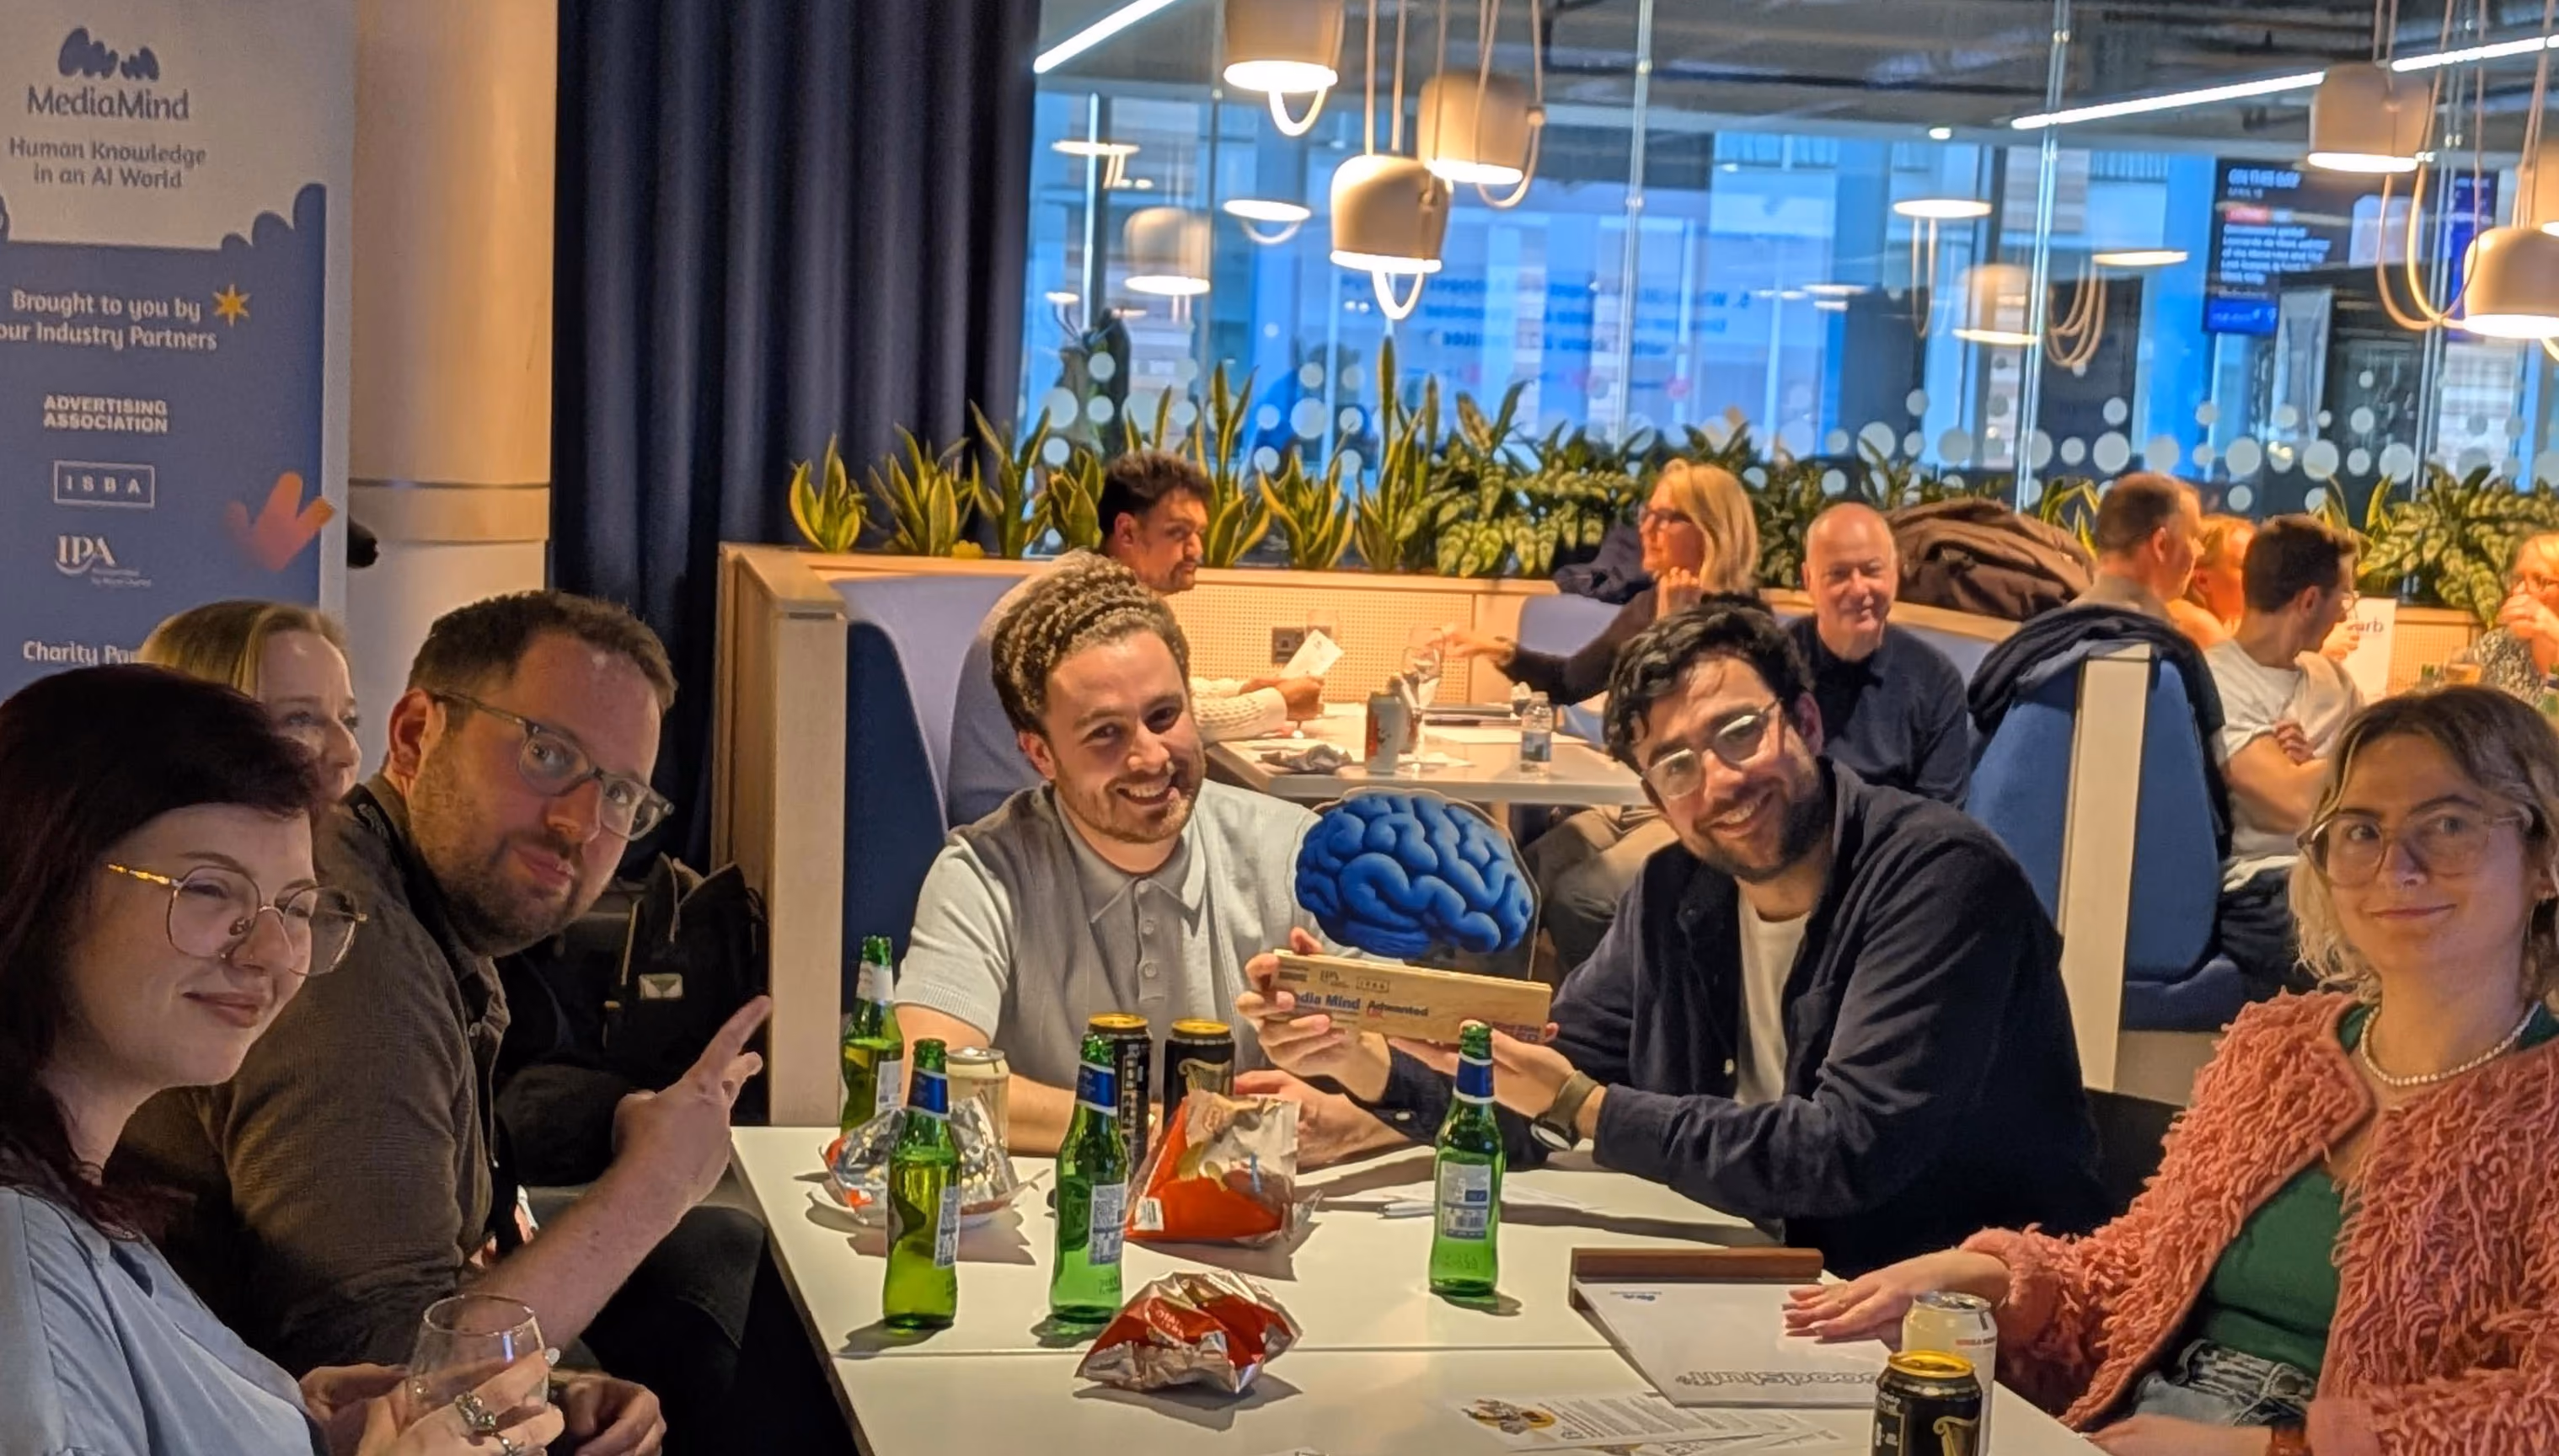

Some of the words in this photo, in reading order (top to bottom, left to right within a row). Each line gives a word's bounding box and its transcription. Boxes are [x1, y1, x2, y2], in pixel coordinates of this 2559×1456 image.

[27, 85, 190, 120] MediaMind
[8, 136, 83, 160] Human
[91, 141, 207, 170] Knowledge
[34, 163, 53, 184] in
[59, 168, 84, 185] an
[91, 167, 112, 186] AI
[119, 169, 183, 190] World
[12, 290, 94, 316] Brought
[100, 295, 122, 315] to
[128, 299, 169, 322] you
[174, 297, 201, 324] by
[36, 322, 124, 351] Industry
[130, 326, 217, 350] Partners
[44, 394, 168, 416] ADVERTISING
[43, 412, 168, 432] ASSOCIATION
[56, 534, 116, 567] IPA
[23, 640, 98, 666] Charity
[104, 645, 138, 664] Par
[1325, 993, 1362, 1010] Mind
